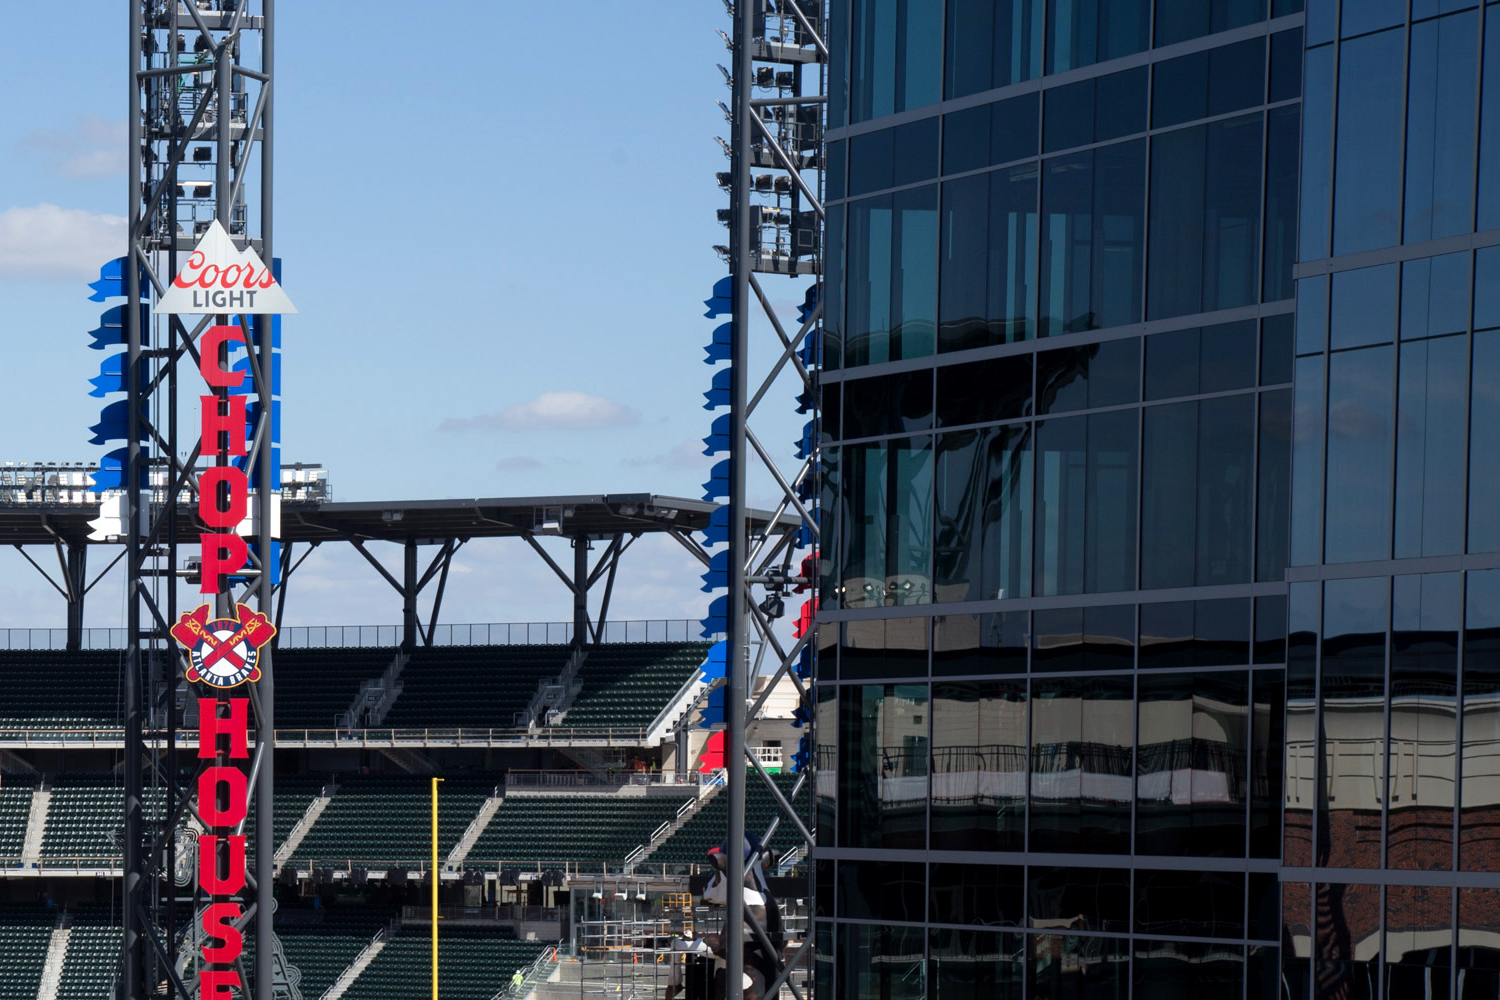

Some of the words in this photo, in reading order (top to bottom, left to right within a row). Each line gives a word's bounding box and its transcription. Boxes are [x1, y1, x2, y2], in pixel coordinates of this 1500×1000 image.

[173, 250, 279, 289] Coors
[193, 290, 257, 308] LIGHT
[199, 325, 249, 594] CHOP
[192, 651, 224, 686] ATLANTA
[229, 651, 257, 685] BRAVES
